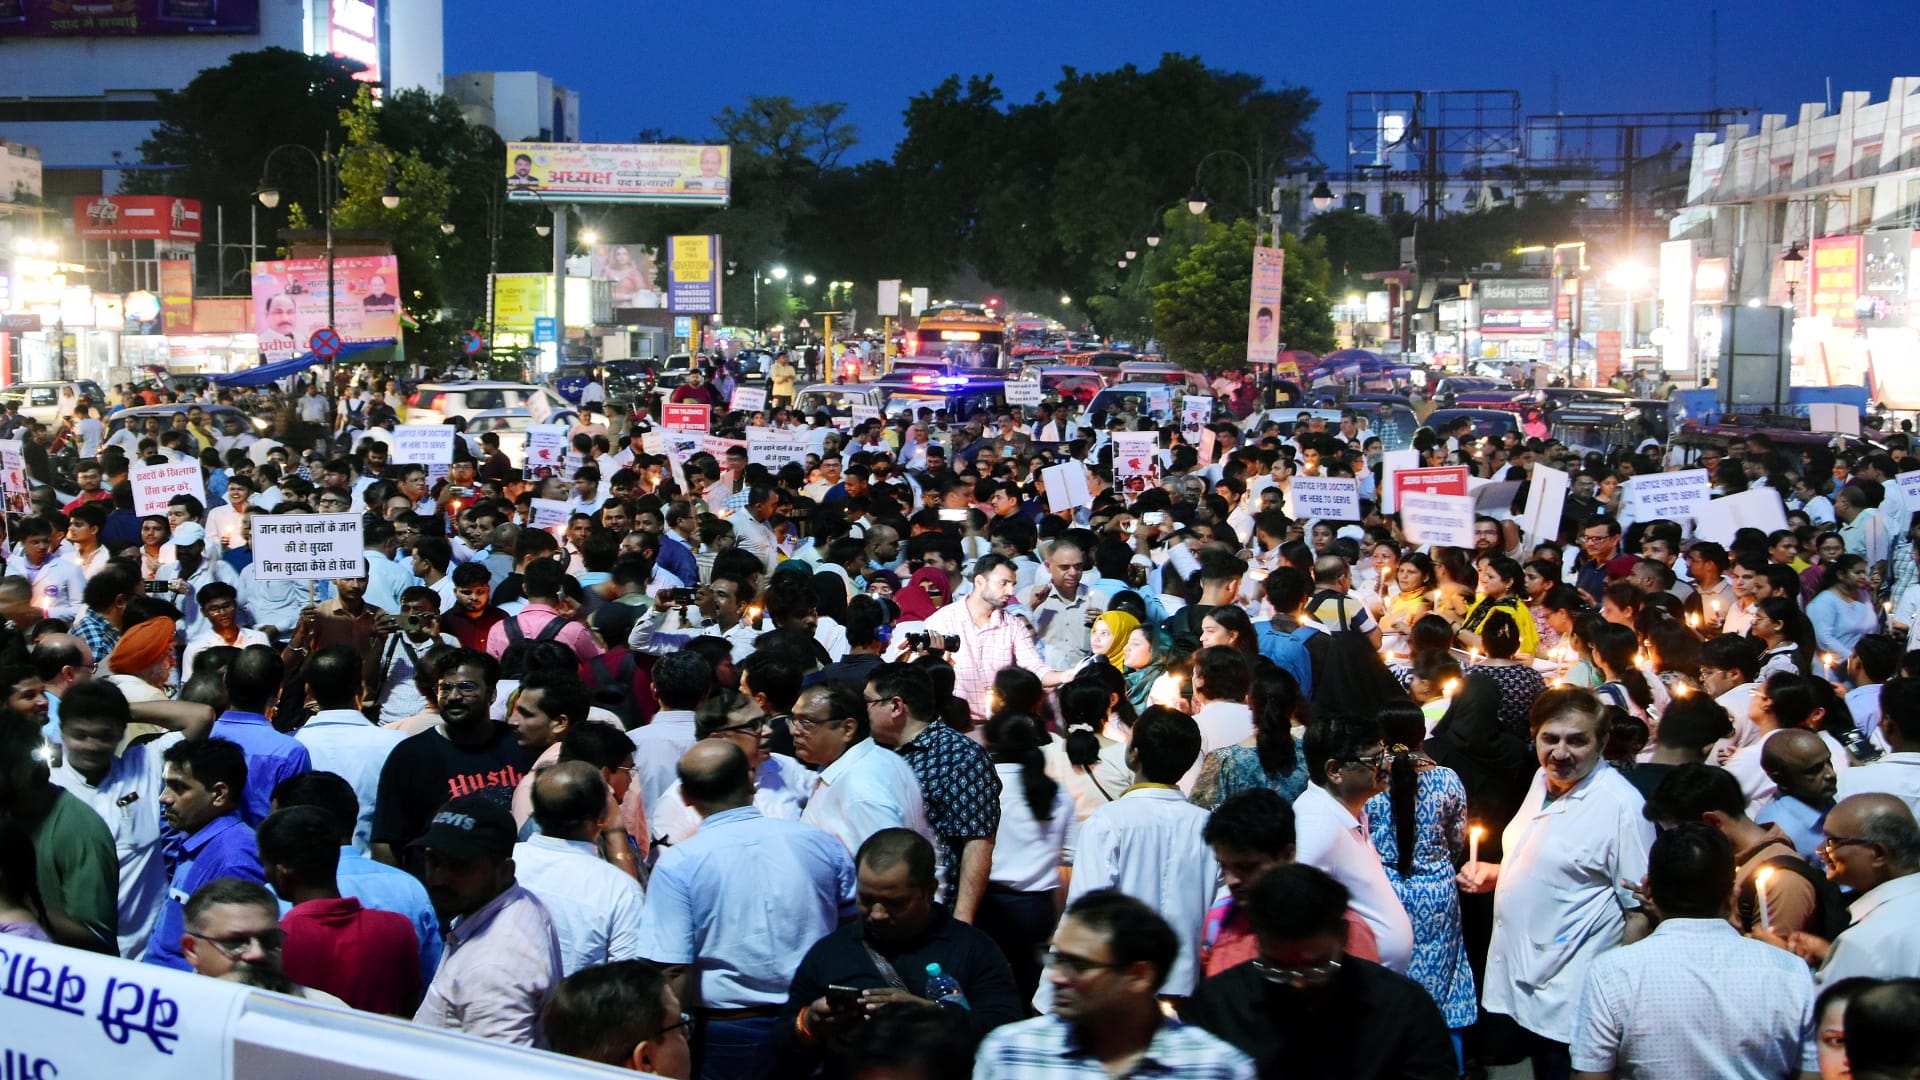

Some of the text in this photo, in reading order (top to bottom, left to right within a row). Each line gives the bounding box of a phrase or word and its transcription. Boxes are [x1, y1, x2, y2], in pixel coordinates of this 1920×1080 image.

[547, 169, 612, 186] अध्यक्ष
[1517, 287, 1549, 299] STREET
[158, 469, 165, 478] के
[166, 467, 197, 477] खिलाफ
[1293, 481, 1356, 491] JUSTICE FOR DOCTORS
[1634, 475, 1705, 491] JUSTICE FOR DOCTORS
[1300, 494, 1351, 504] WE HERE TO SERVE
[1641, 489, 1702, 504] WE HERE TO SERVE
[156, 501, 169, 510] न्या
[1311, 507, 1342, 516] NOT TO DIE
[1655, 505, 1691, 516] NOT TO DIE
[259, 520, 356, 534] जान बचाने वालों के जान
[284, 540, 333, 556] की हो सुरक्षा
[263, 557, 356, 576] बिना सुरक्षा कैसे हो सेवा
[97, 977, 180, 1055] बेटी
